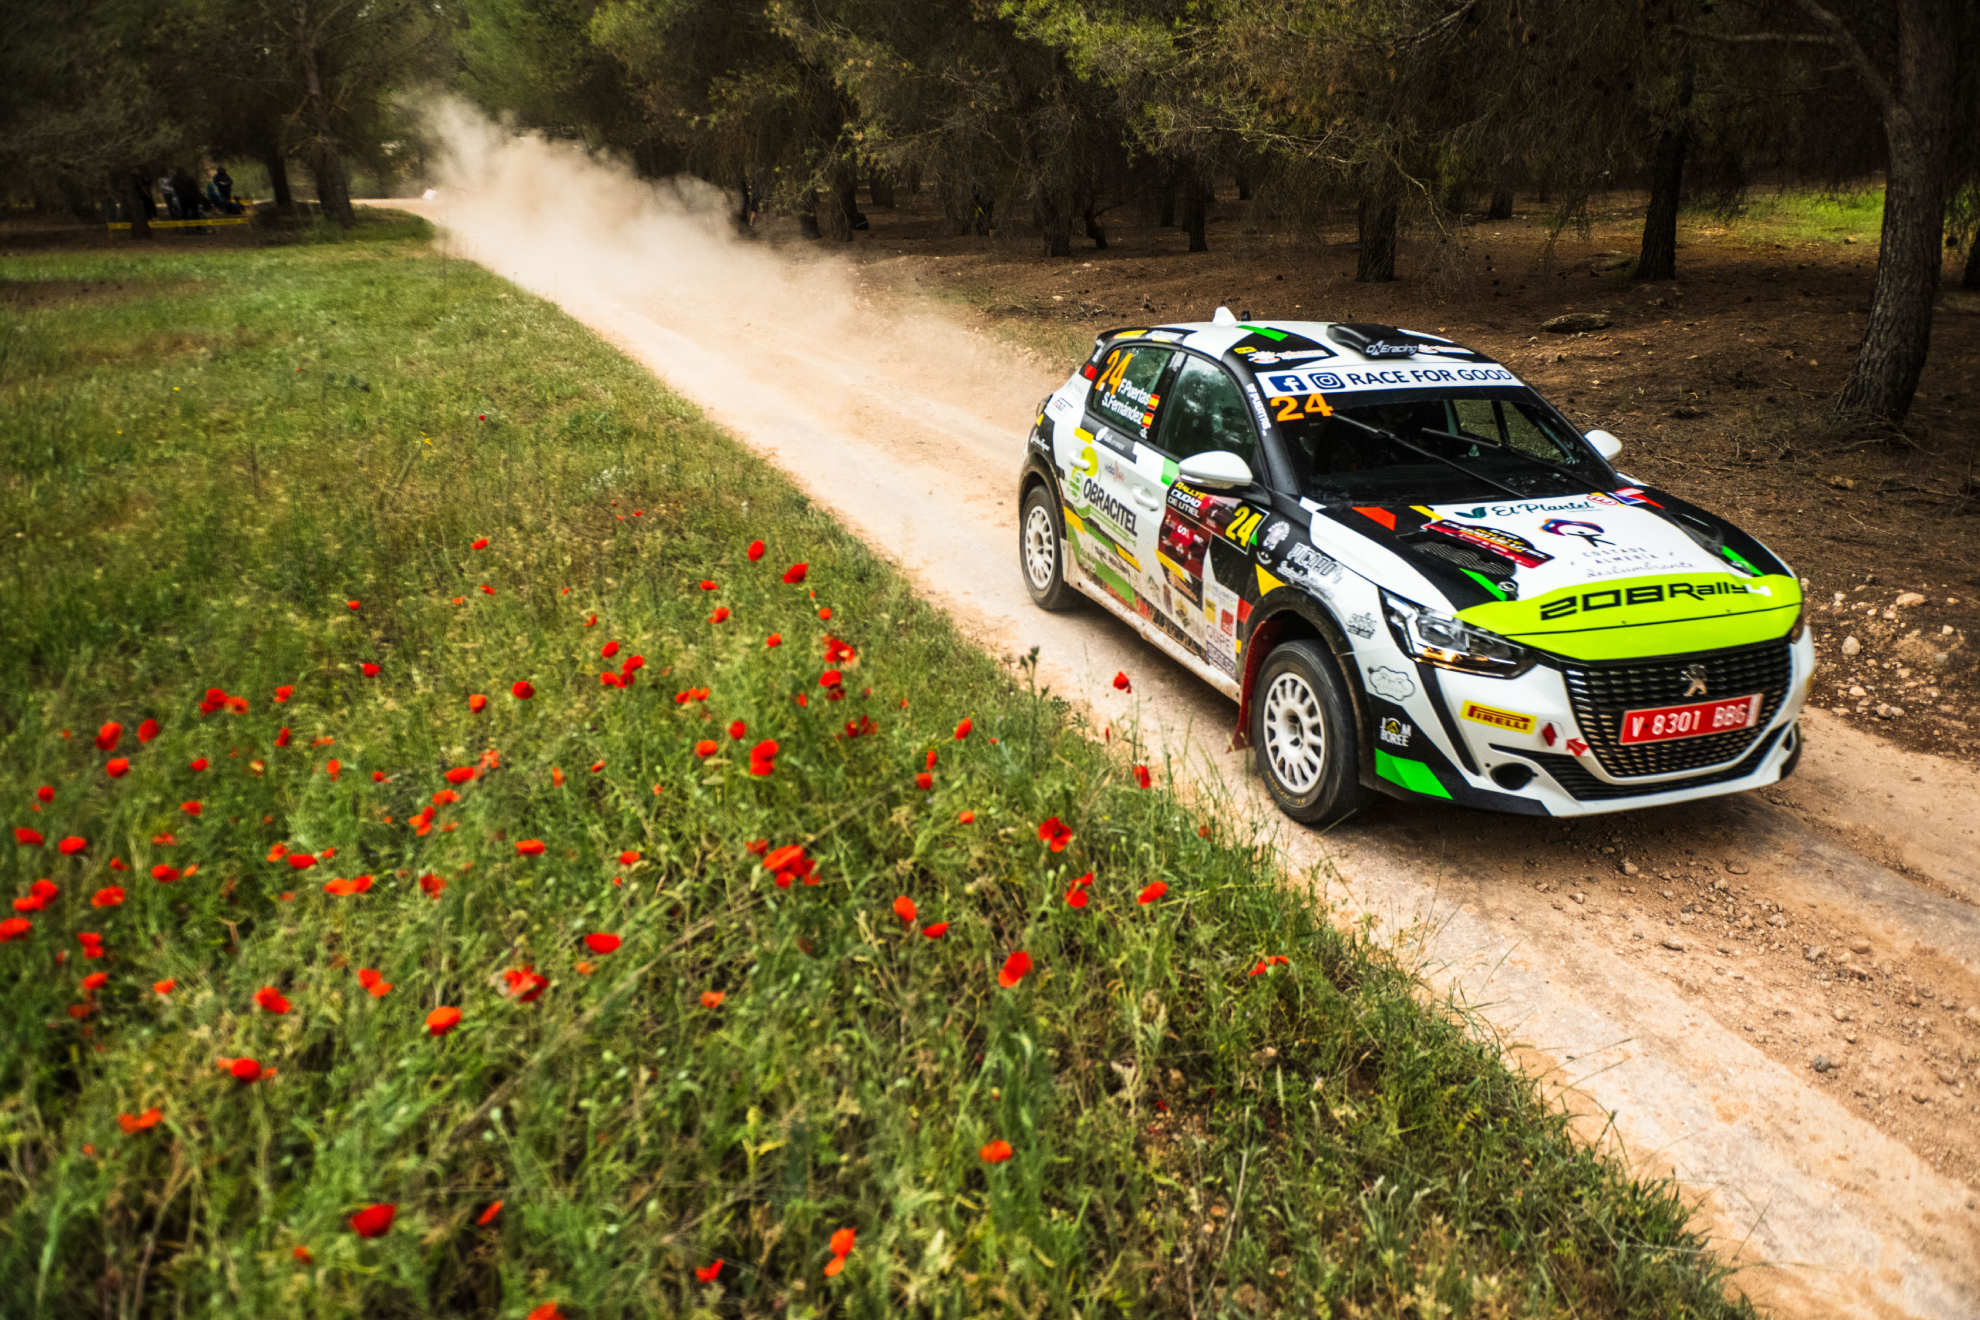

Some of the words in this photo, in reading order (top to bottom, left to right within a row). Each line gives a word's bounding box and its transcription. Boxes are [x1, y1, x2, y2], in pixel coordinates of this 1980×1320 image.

[1095, 349, 1133, 395] 24
[1346, 371, 1410, 385] RACE
[1410, 369, 1457, 382] FOR
[1457, 369, 1512, 381] GOOD
[1270, 393, 1334, 422] 24
[1168, 496, 1178, 507] DE
[1175, 481, 1207, 500] RALLYE
[1083, 478, 1138, 537] OBRACITEL
[1491, 505, 1519, 516] El
[1517, 502, 1594, 513] Plantel
[1225, 506, 1263, 547] 24
[1539, 585, 1665, 620] 208
[1467, 705, 1531, 730] PIRELLI
[1632, 716, 1645, 737] V
[1652, 710, 1701, 735] 8301
